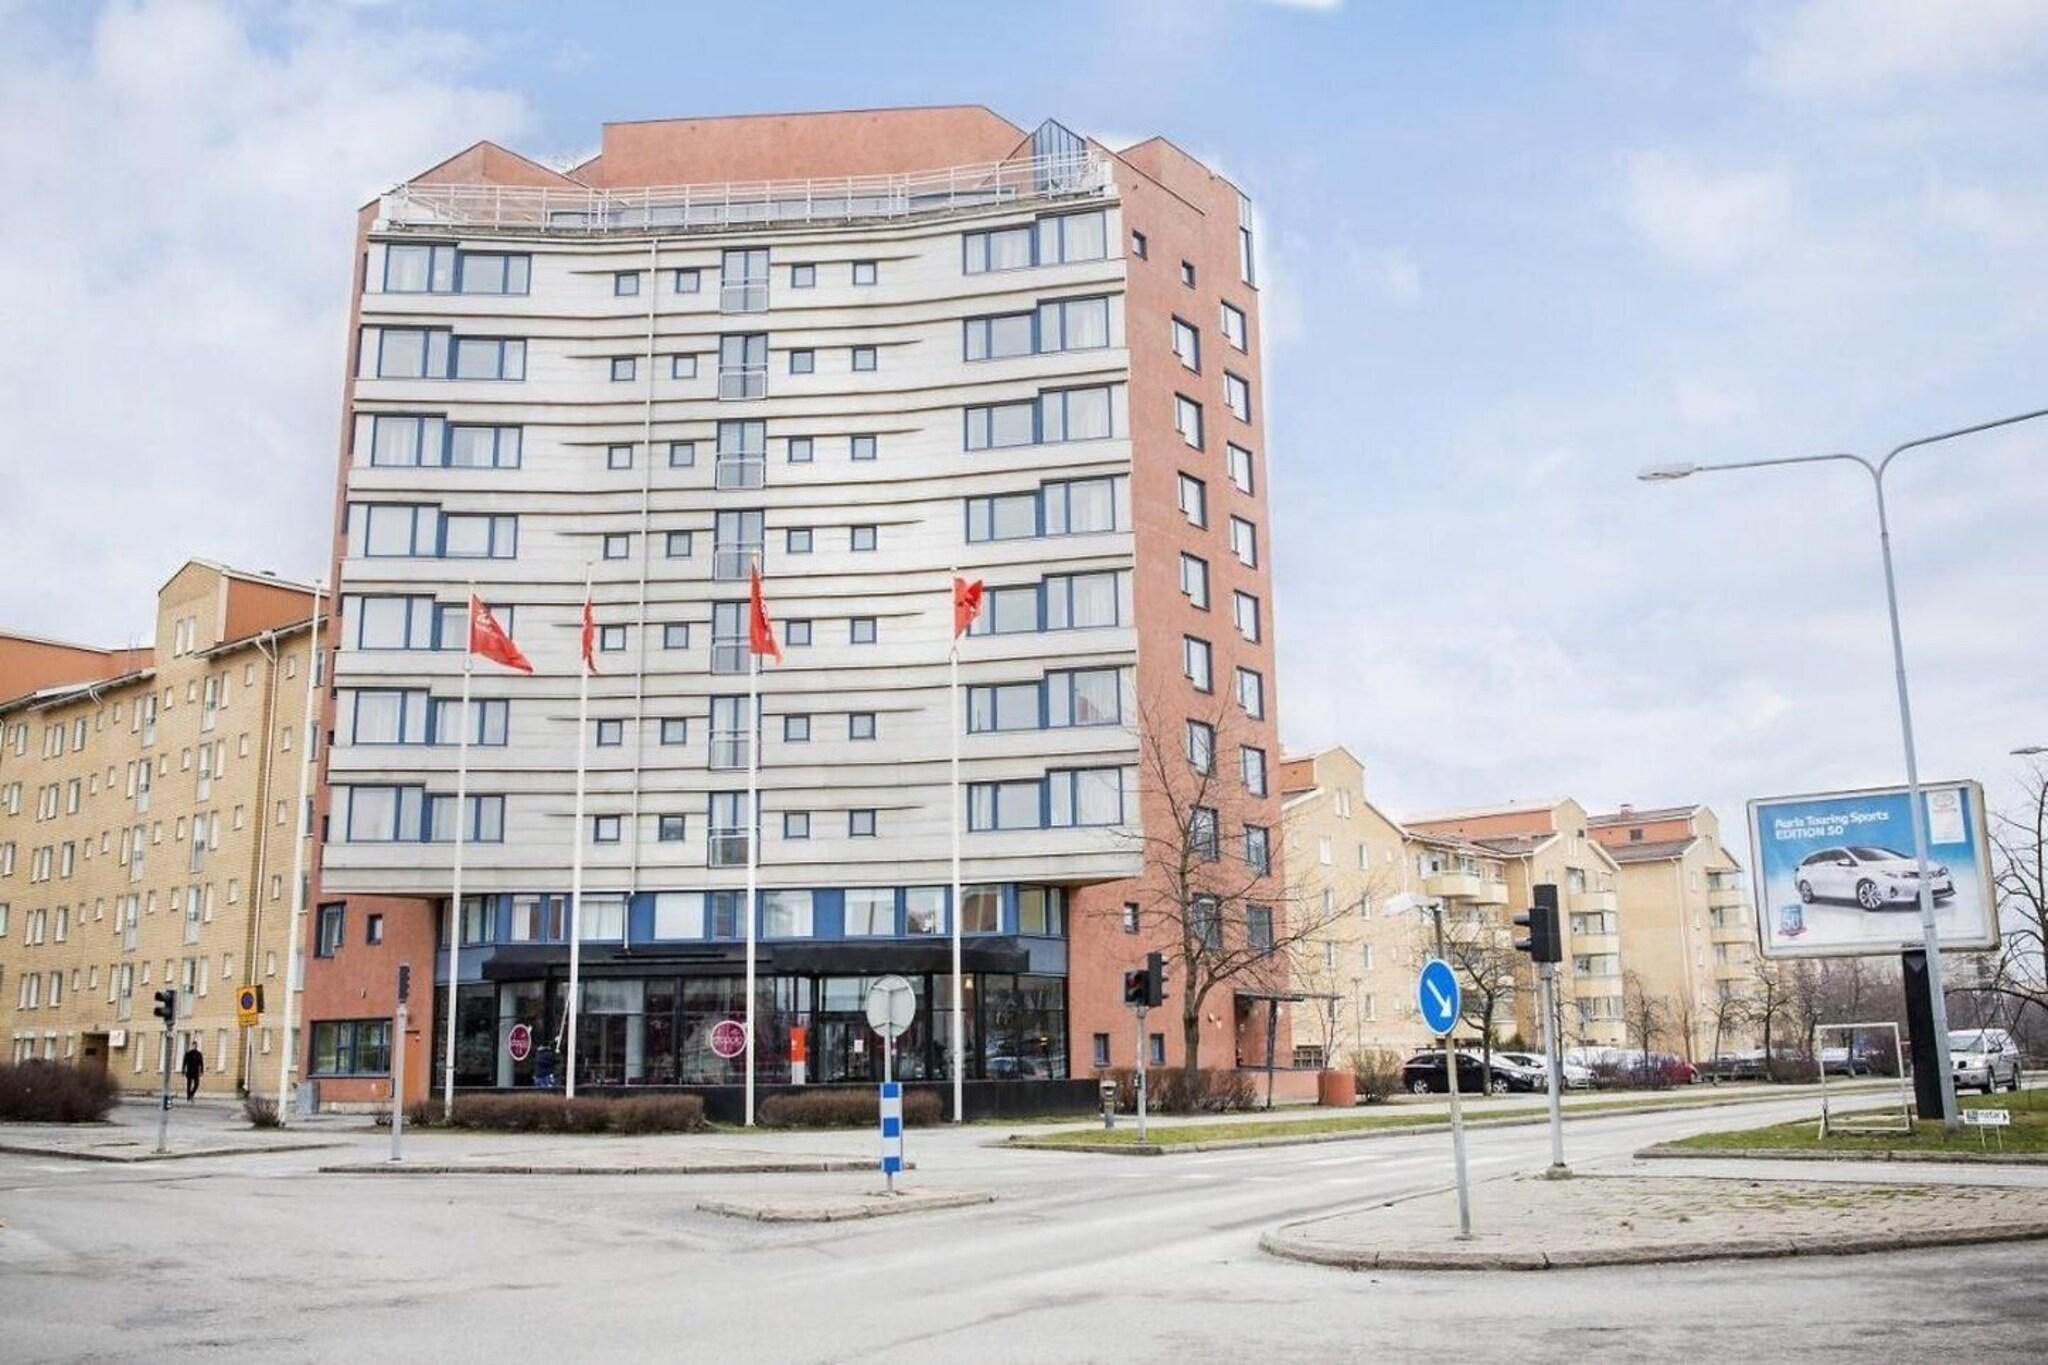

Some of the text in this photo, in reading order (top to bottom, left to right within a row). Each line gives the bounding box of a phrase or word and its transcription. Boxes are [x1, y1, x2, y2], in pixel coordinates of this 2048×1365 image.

[1806, 814, 1849, 826] Touring
[1850, 811, 1889, 824] Sports
[1775, 825, 1844, 840] EDITION 50
